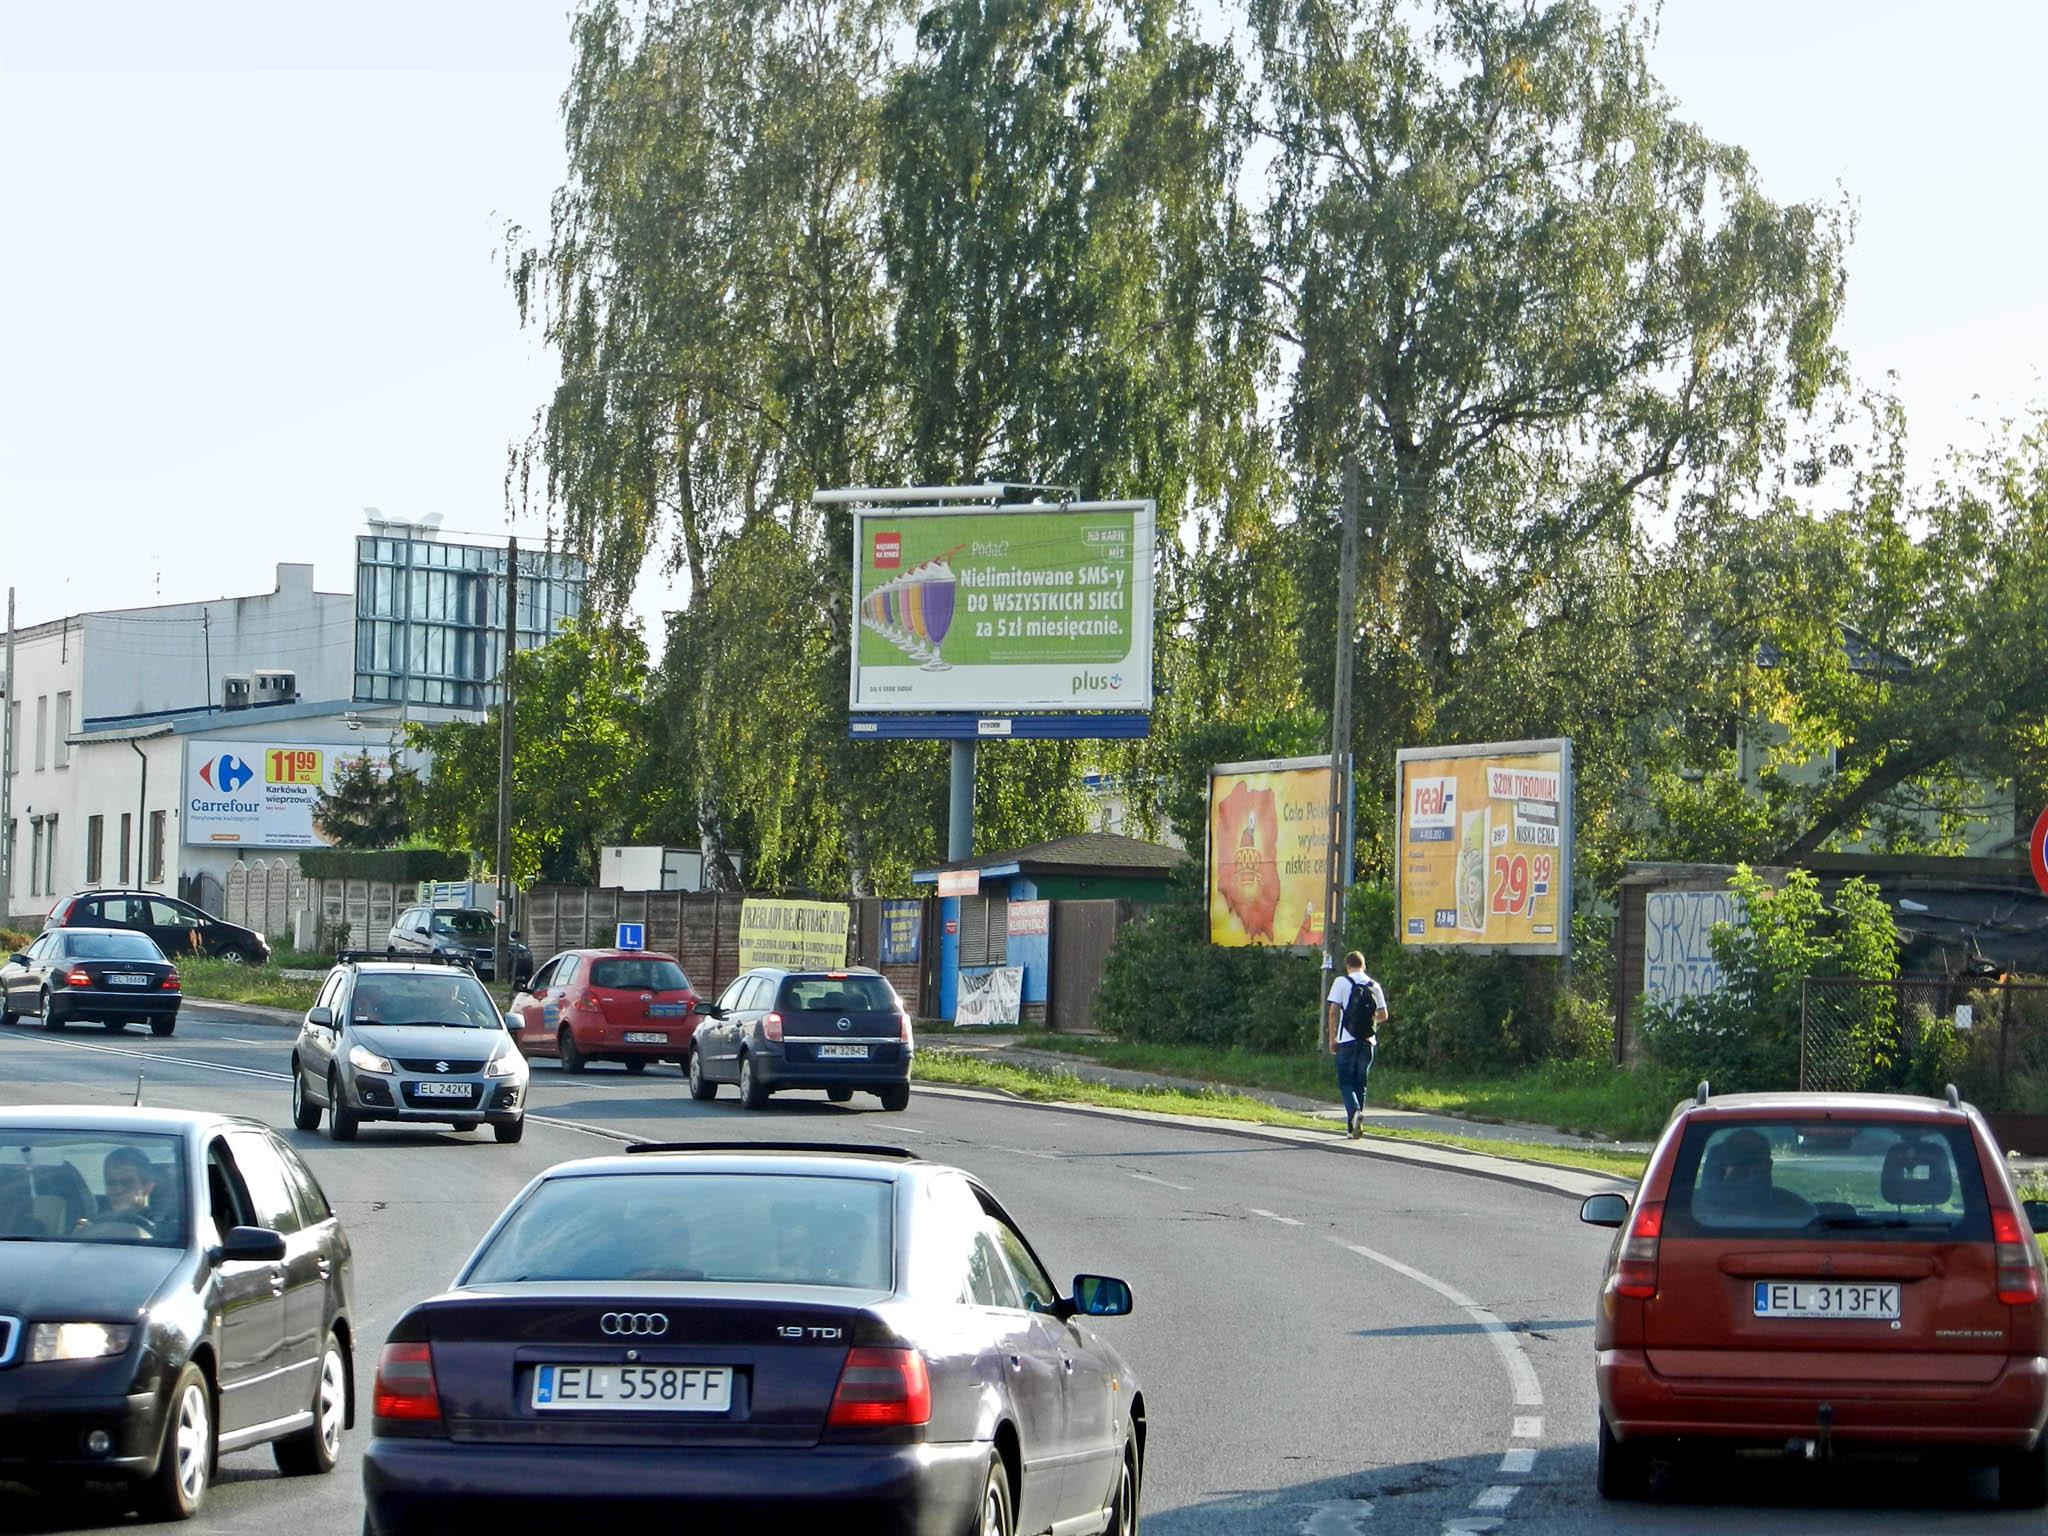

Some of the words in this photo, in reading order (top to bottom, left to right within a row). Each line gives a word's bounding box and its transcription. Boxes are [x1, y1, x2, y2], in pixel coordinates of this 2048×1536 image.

[961, 567, 1074, 588] Nielimitowane
[1079, 566, 1125, 589] SMS-y
[967, 594, 988, 612] DO
[992, 592, 1084, 612] WSZYSTKICH
[1088, 591, 1124, 610] SIECI
[976, 622, 992, 637] za
[998, 619, 1006, 637] 5
[1009, 616, 1022, 637] zł
[1027, 615, 1123, 640] miesięcznie.
[1072, 671, 1107, 694] plus
[266, 786, 307, 794] Karkówka
[1493, 773, 1513, 795] SZOK
[1514, 774, 1556, 800] TYGODNIA!
[191, 799, 260, 813] Carrefour
[1306, 800, 1329, 821] Polsk
[1517, 825, 1535, 843] NISKA
[1537, 827, 1555, 844] CENA
[627, 928, 638, 945] L
[421, 1084, 435, 1094] EL
[440, 1084, 471, 1095] 242KK
[1772, 1286, 1807, 1310] EL
[1818, 1288, 1894, 1312] 313FK
[808, 1327, 842, 1339] TDI
[558, 1368, 603, 1399] EL
[619, 1369, 724, 1401] 558FF
